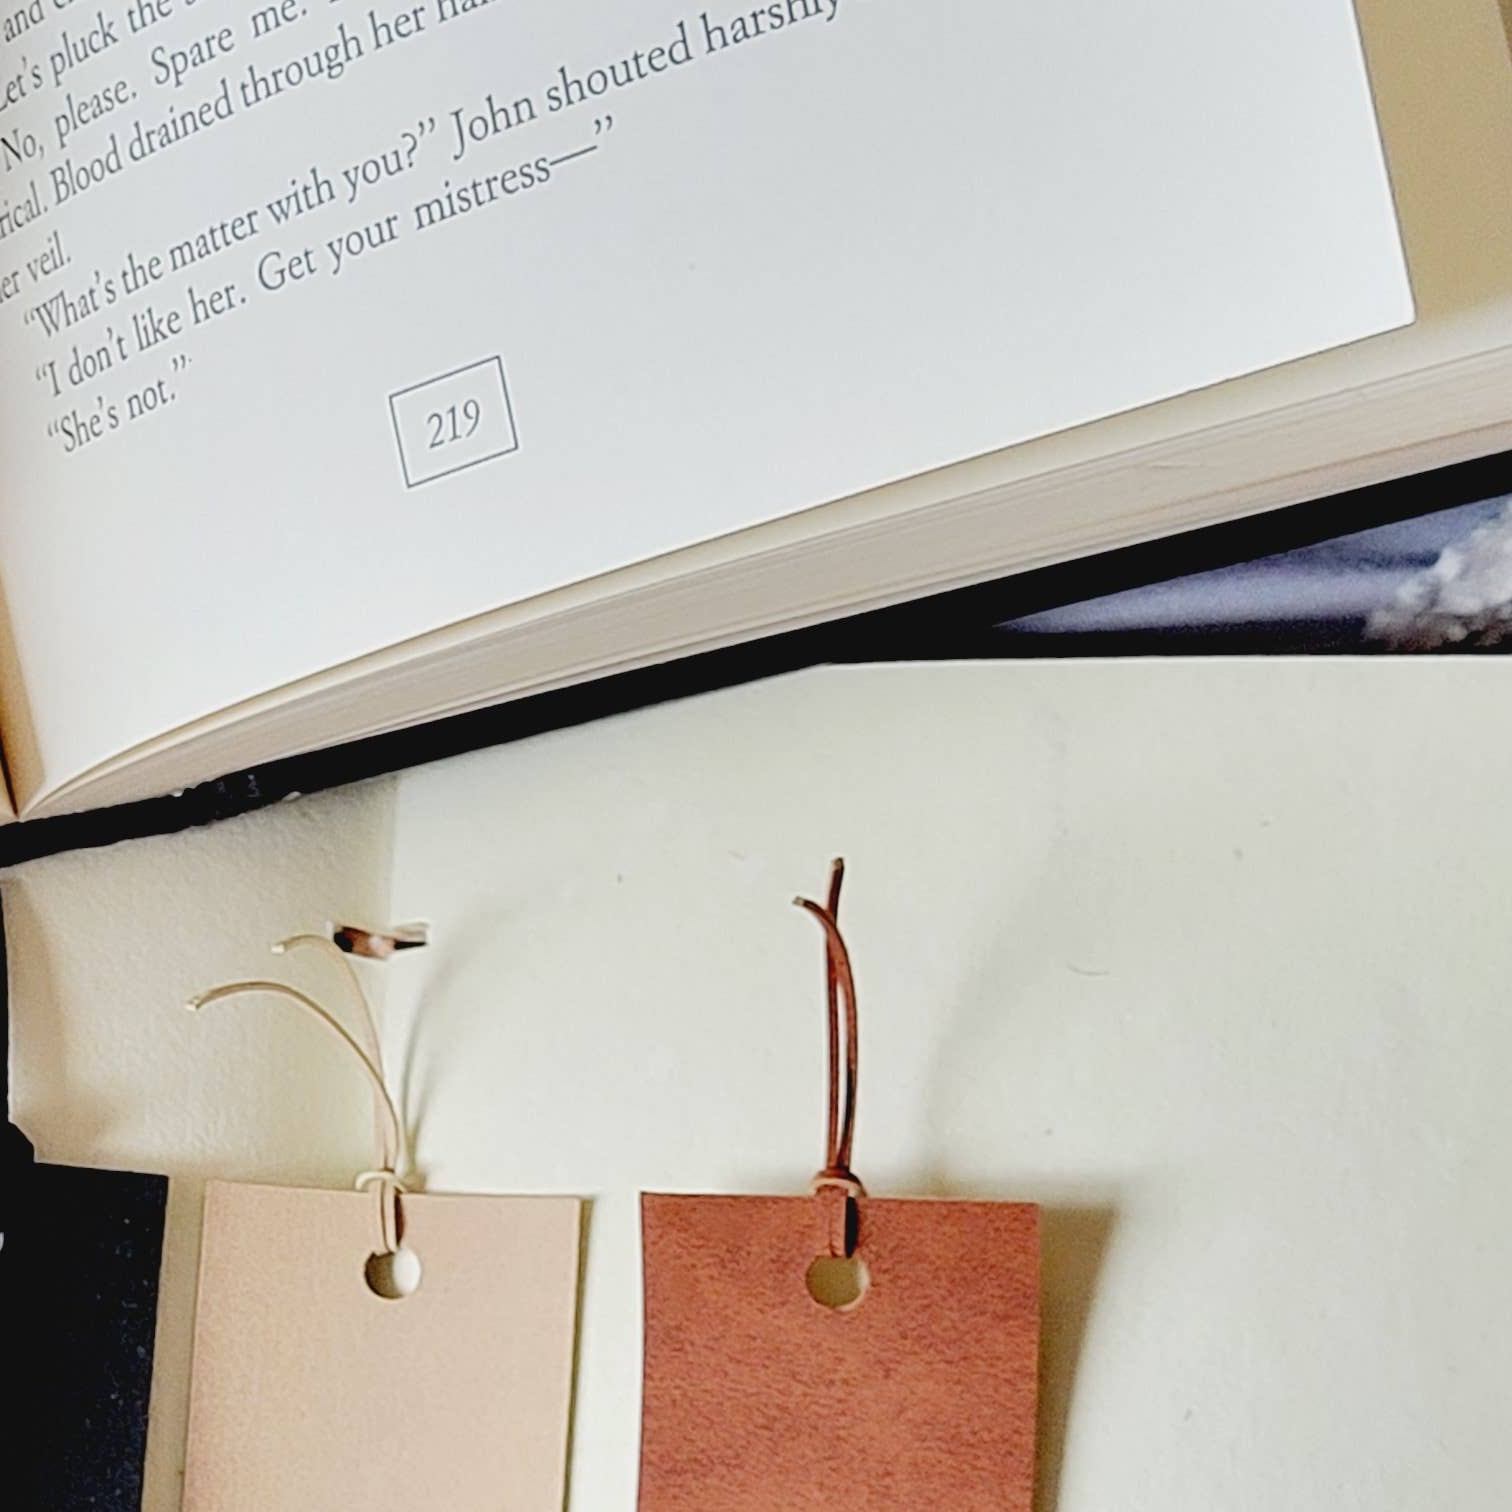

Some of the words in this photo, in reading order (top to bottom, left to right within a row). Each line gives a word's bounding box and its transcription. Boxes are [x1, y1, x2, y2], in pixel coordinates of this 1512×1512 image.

[3, 0, 45, 43] and
[49, 10, 119, 88] pluck
[126, 0, 173, 34] the
[49, 132, 124, 206] Blood
[128, 77, 235, 162] drained
[239, 22, 365, 108] through
[367, 5, 426, 51] her
[53, 80, 137, 150] please.
[150, 27, 235, 89] Spare
[251, 0, 308, 39] me.
[23, 269, 117, 341] “What’s
[120, 252, 164, 295] the
[168, 209, 259, 273] matter
[265, 166, 336, 225] with
[341, 116, 436, 204] you?”
[449, 93, 538, 161] John
[545, 19, 694, 113] shouted
[26, 229, 72, 283] veil.
[35, 360, 62, 398] “I
[68, 326, 129, 387] don’t
[132, 306, 183, 352] like
[187, 284, 247, 325] her.
[257, 247, 318, 291] Get
[326, 214, 399, 276] your
[47, 395, 120, 453] “She’s
[126, 353, 186, 421] not.”
[426, 398, 481, 449] 219
